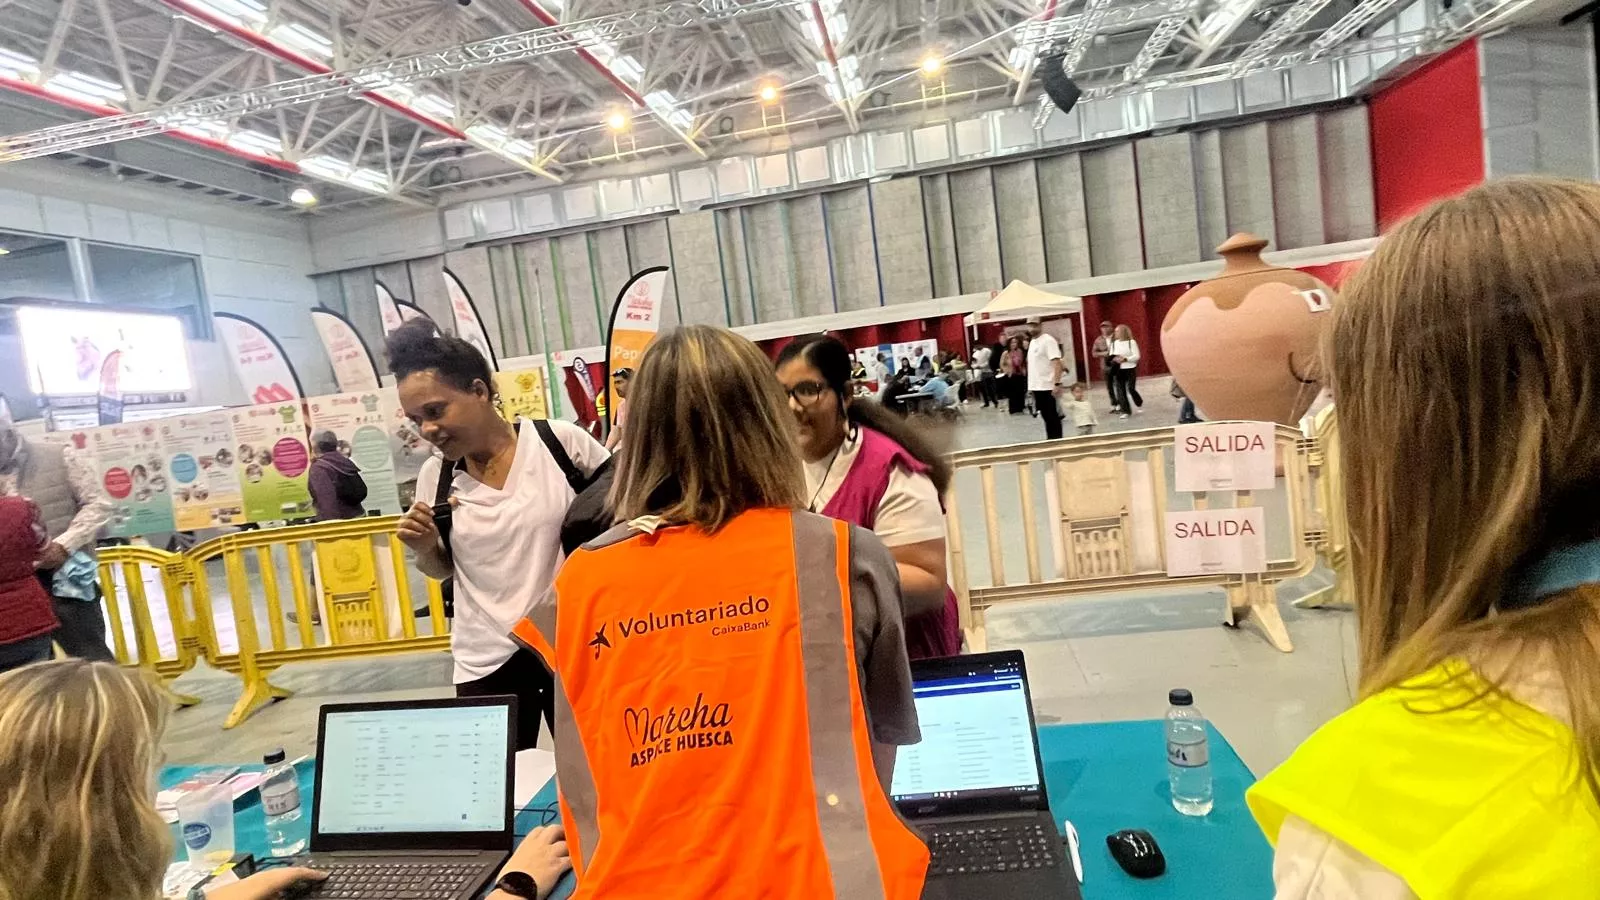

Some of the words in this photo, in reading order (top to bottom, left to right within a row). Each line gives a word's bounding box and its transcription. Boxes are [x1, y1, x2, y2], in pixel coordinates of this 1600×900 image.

[626, 312, 642, 321] Km
[644, 313, 651, 321] 2
[1185, 434, 1265, 453] SALIDA
[1175, 519, 1255, 538] SALIDA
[618, 595, 770, 639] Voluntariado
[711, 618, 771, 637] CaixaBank
[624, 692, 734, 748] Marcha
[676, 730, 734, 752] HUESCA
